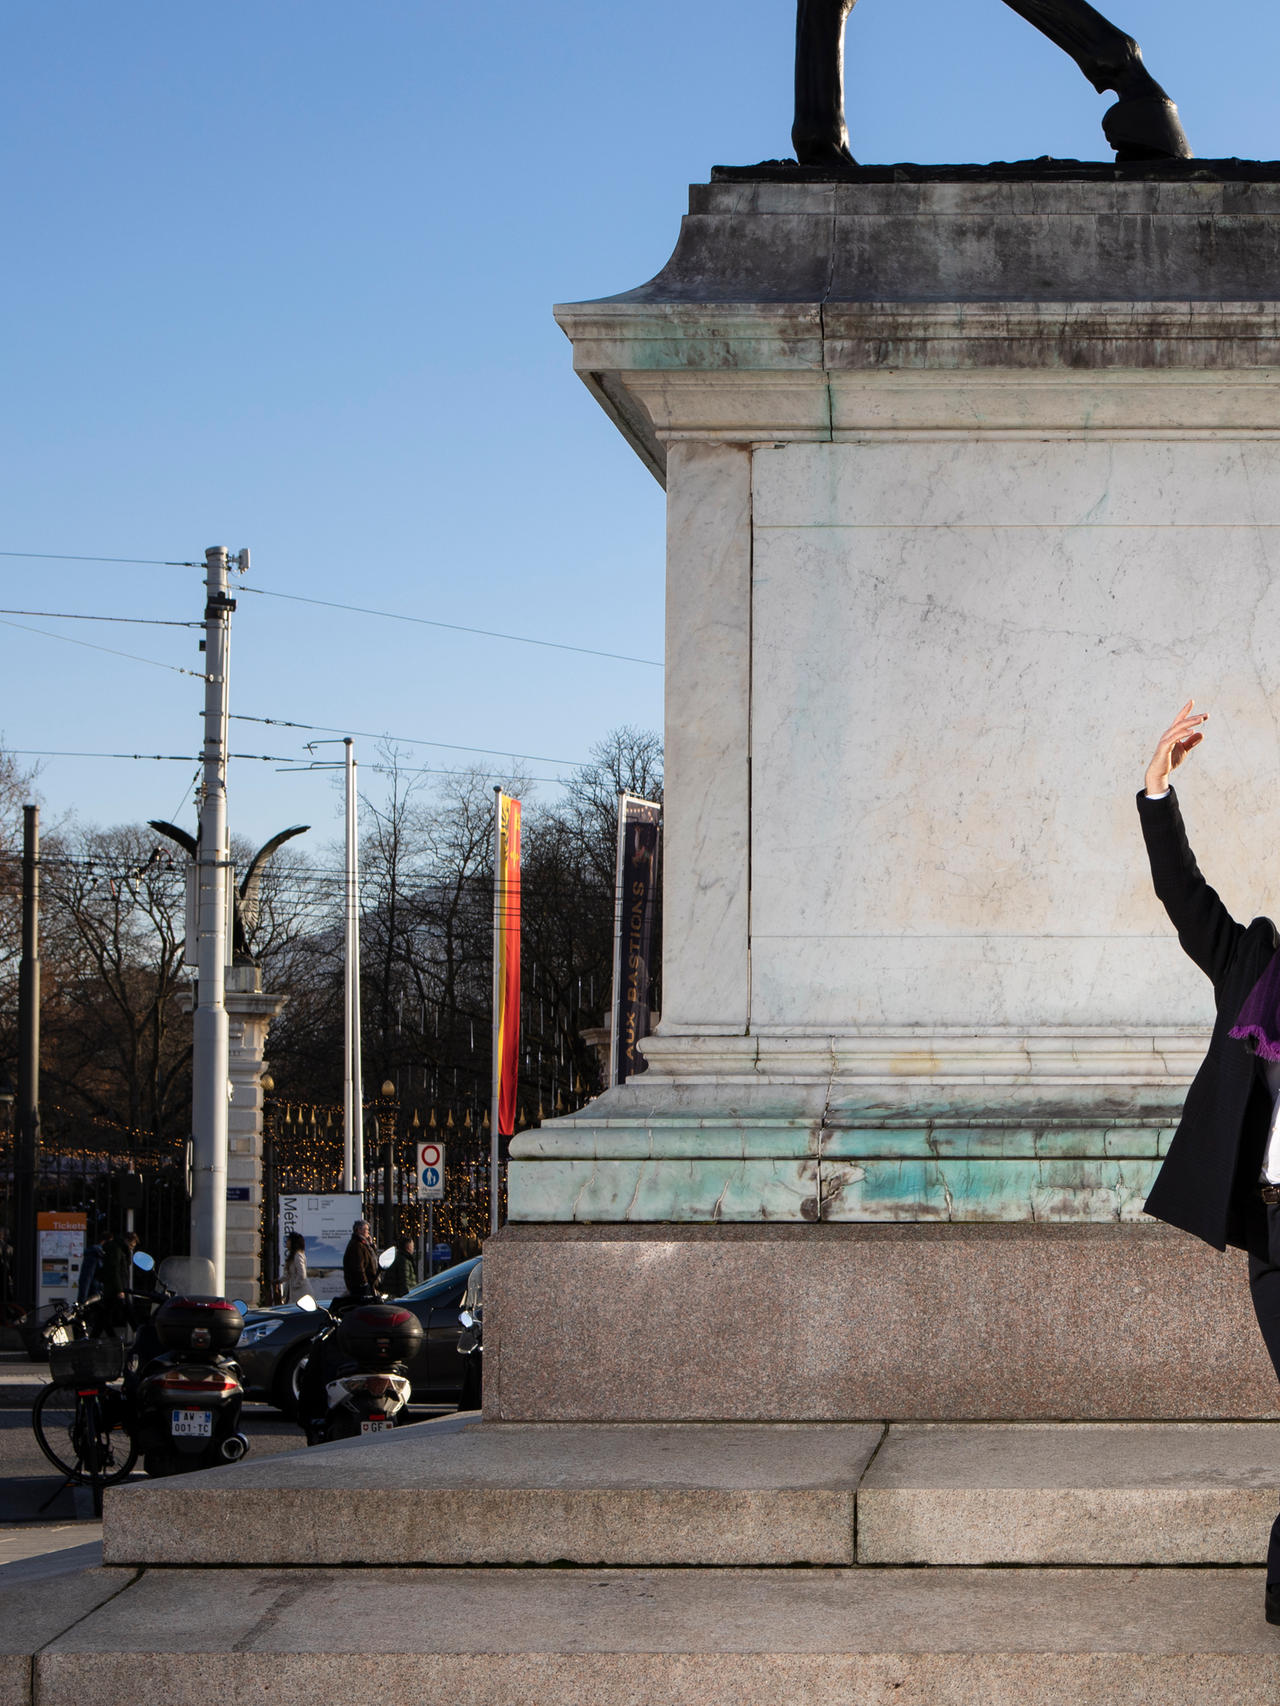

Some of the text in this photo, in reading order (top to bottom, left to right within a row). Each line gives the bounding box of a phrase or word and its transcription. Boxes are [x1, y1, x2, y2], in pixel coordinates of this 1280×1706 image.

[625, 880, 645, 1060] AUX BASTIONS
[53, 1221, 87, 1230] Tickets
